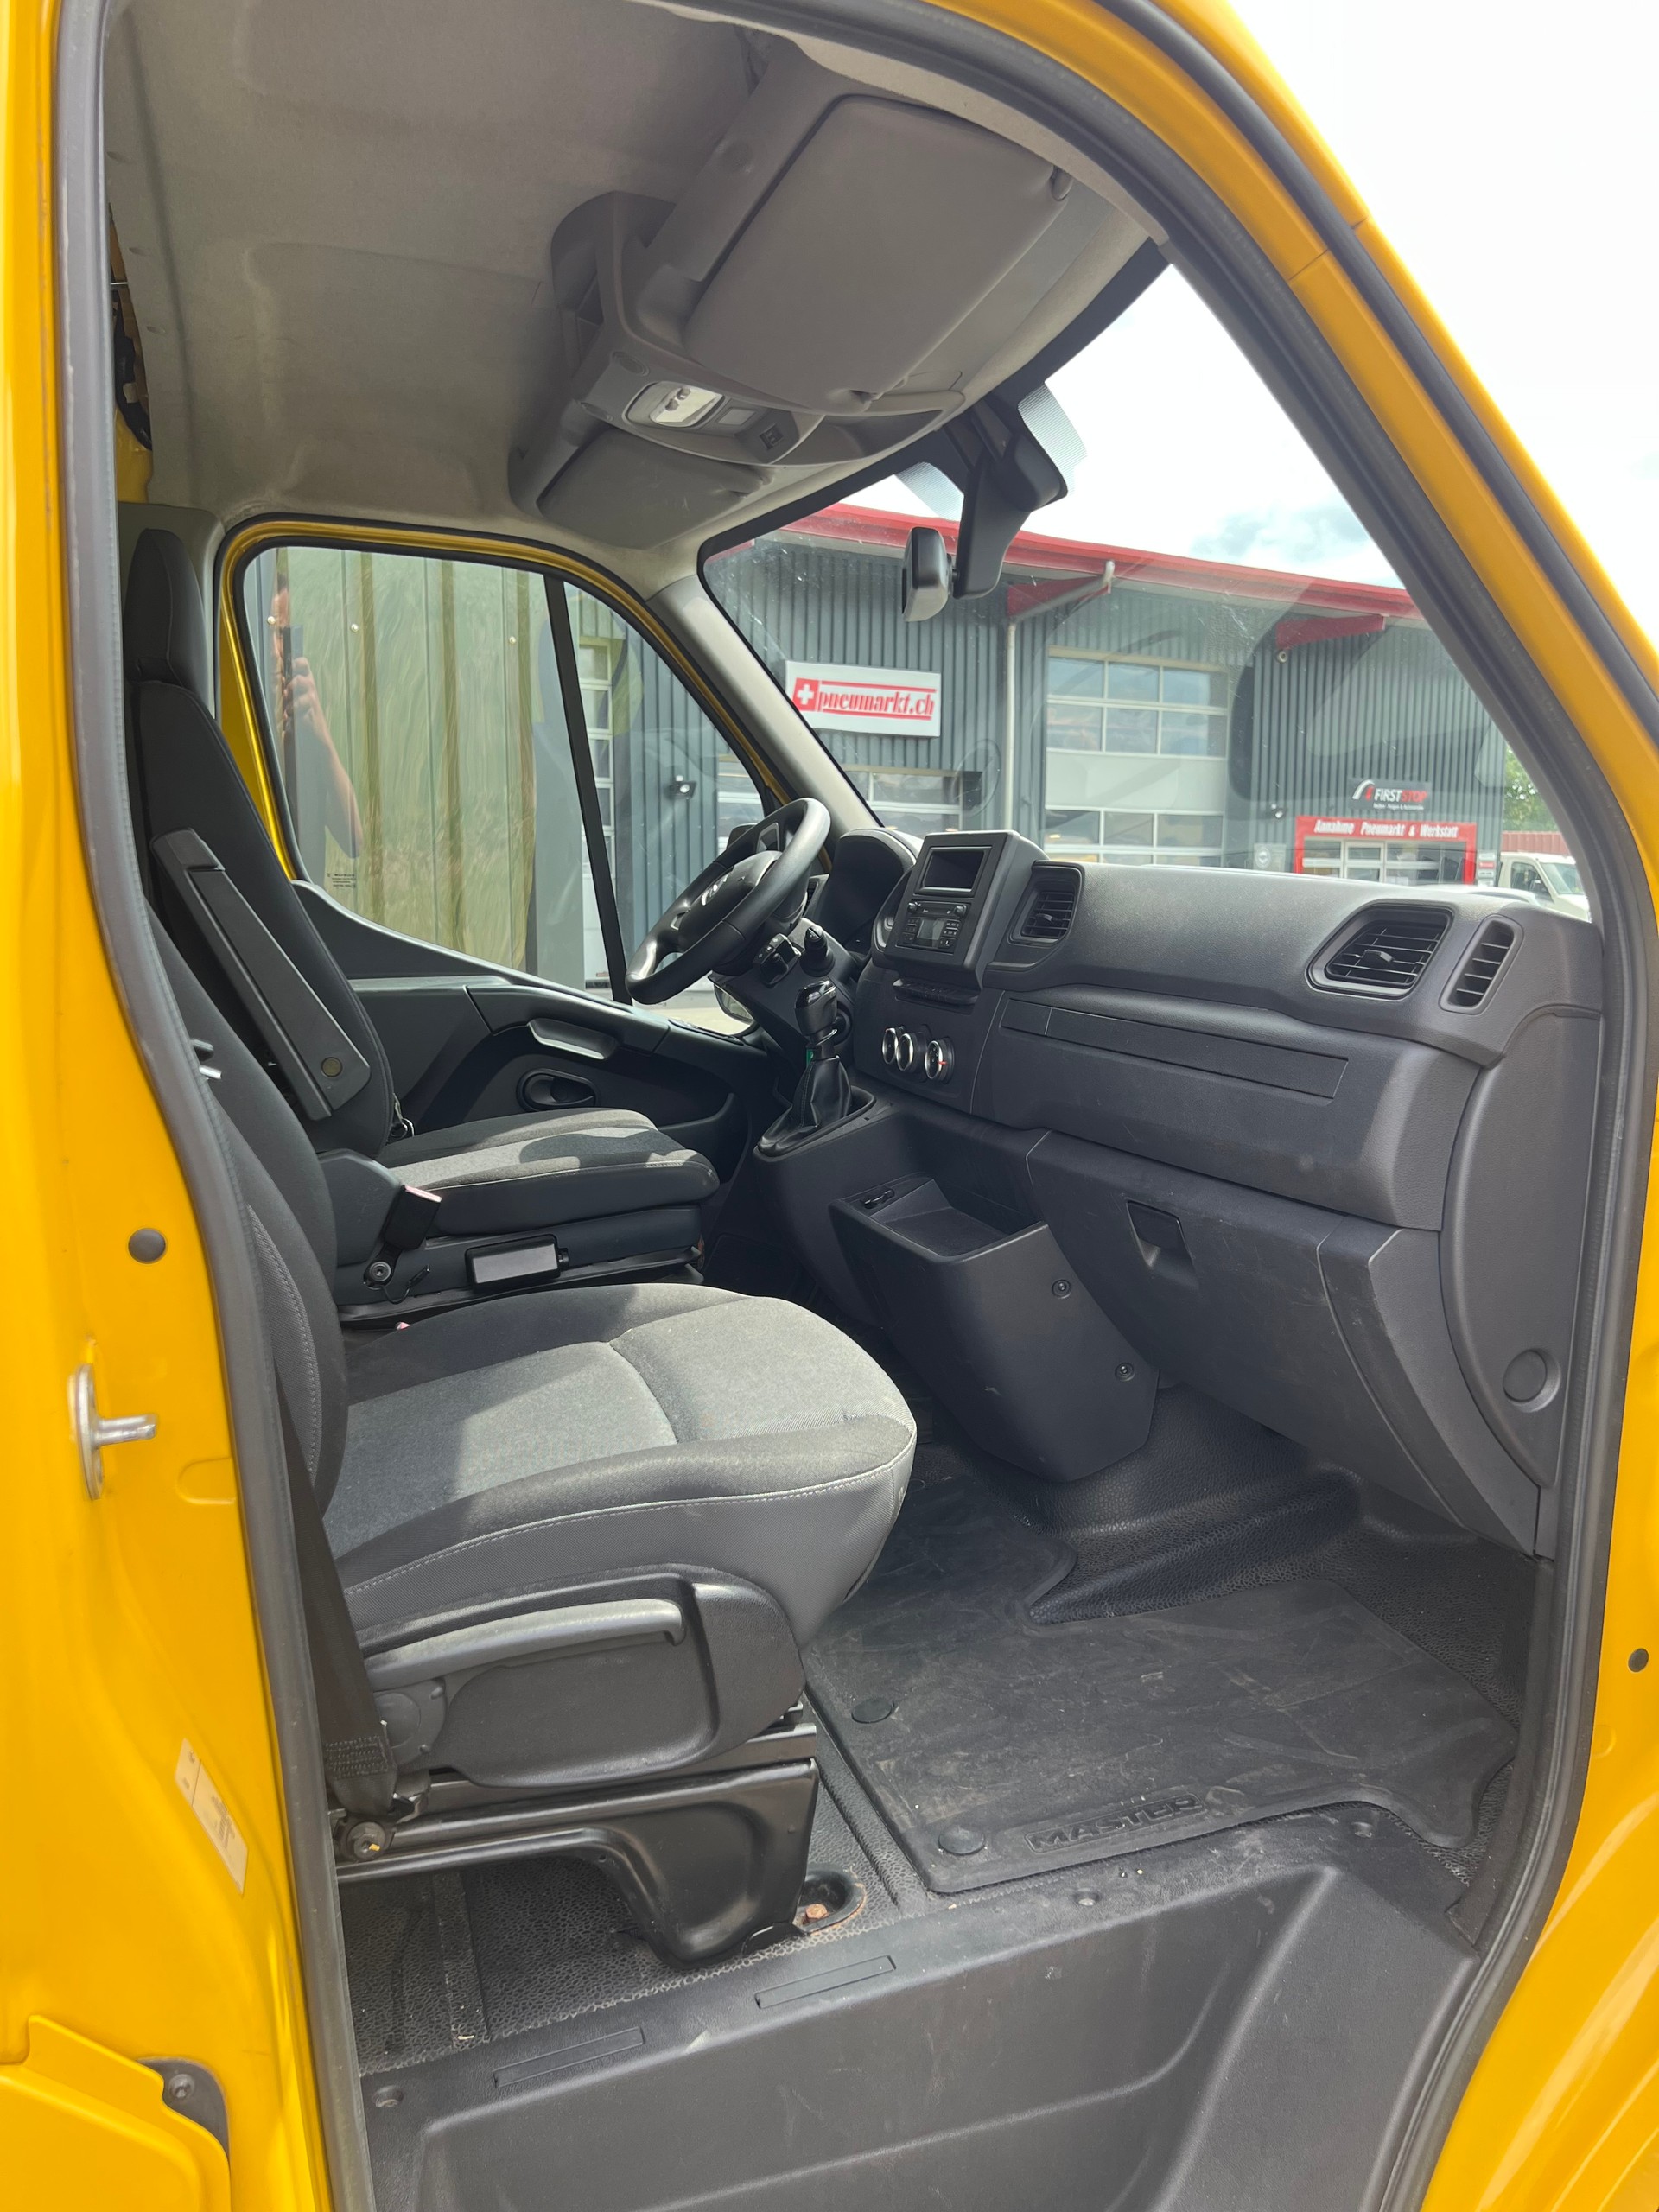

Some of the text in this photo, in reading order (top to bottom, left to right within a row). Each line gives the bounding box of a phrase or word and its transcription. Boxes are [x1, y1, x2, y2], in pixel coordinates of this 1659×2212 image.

[817, 690, 936, 715] pneumarkt.ch
[1420, 823, 1459, 838] Werkstatt
[1033, 1796, 1205, 1847] MASTER
